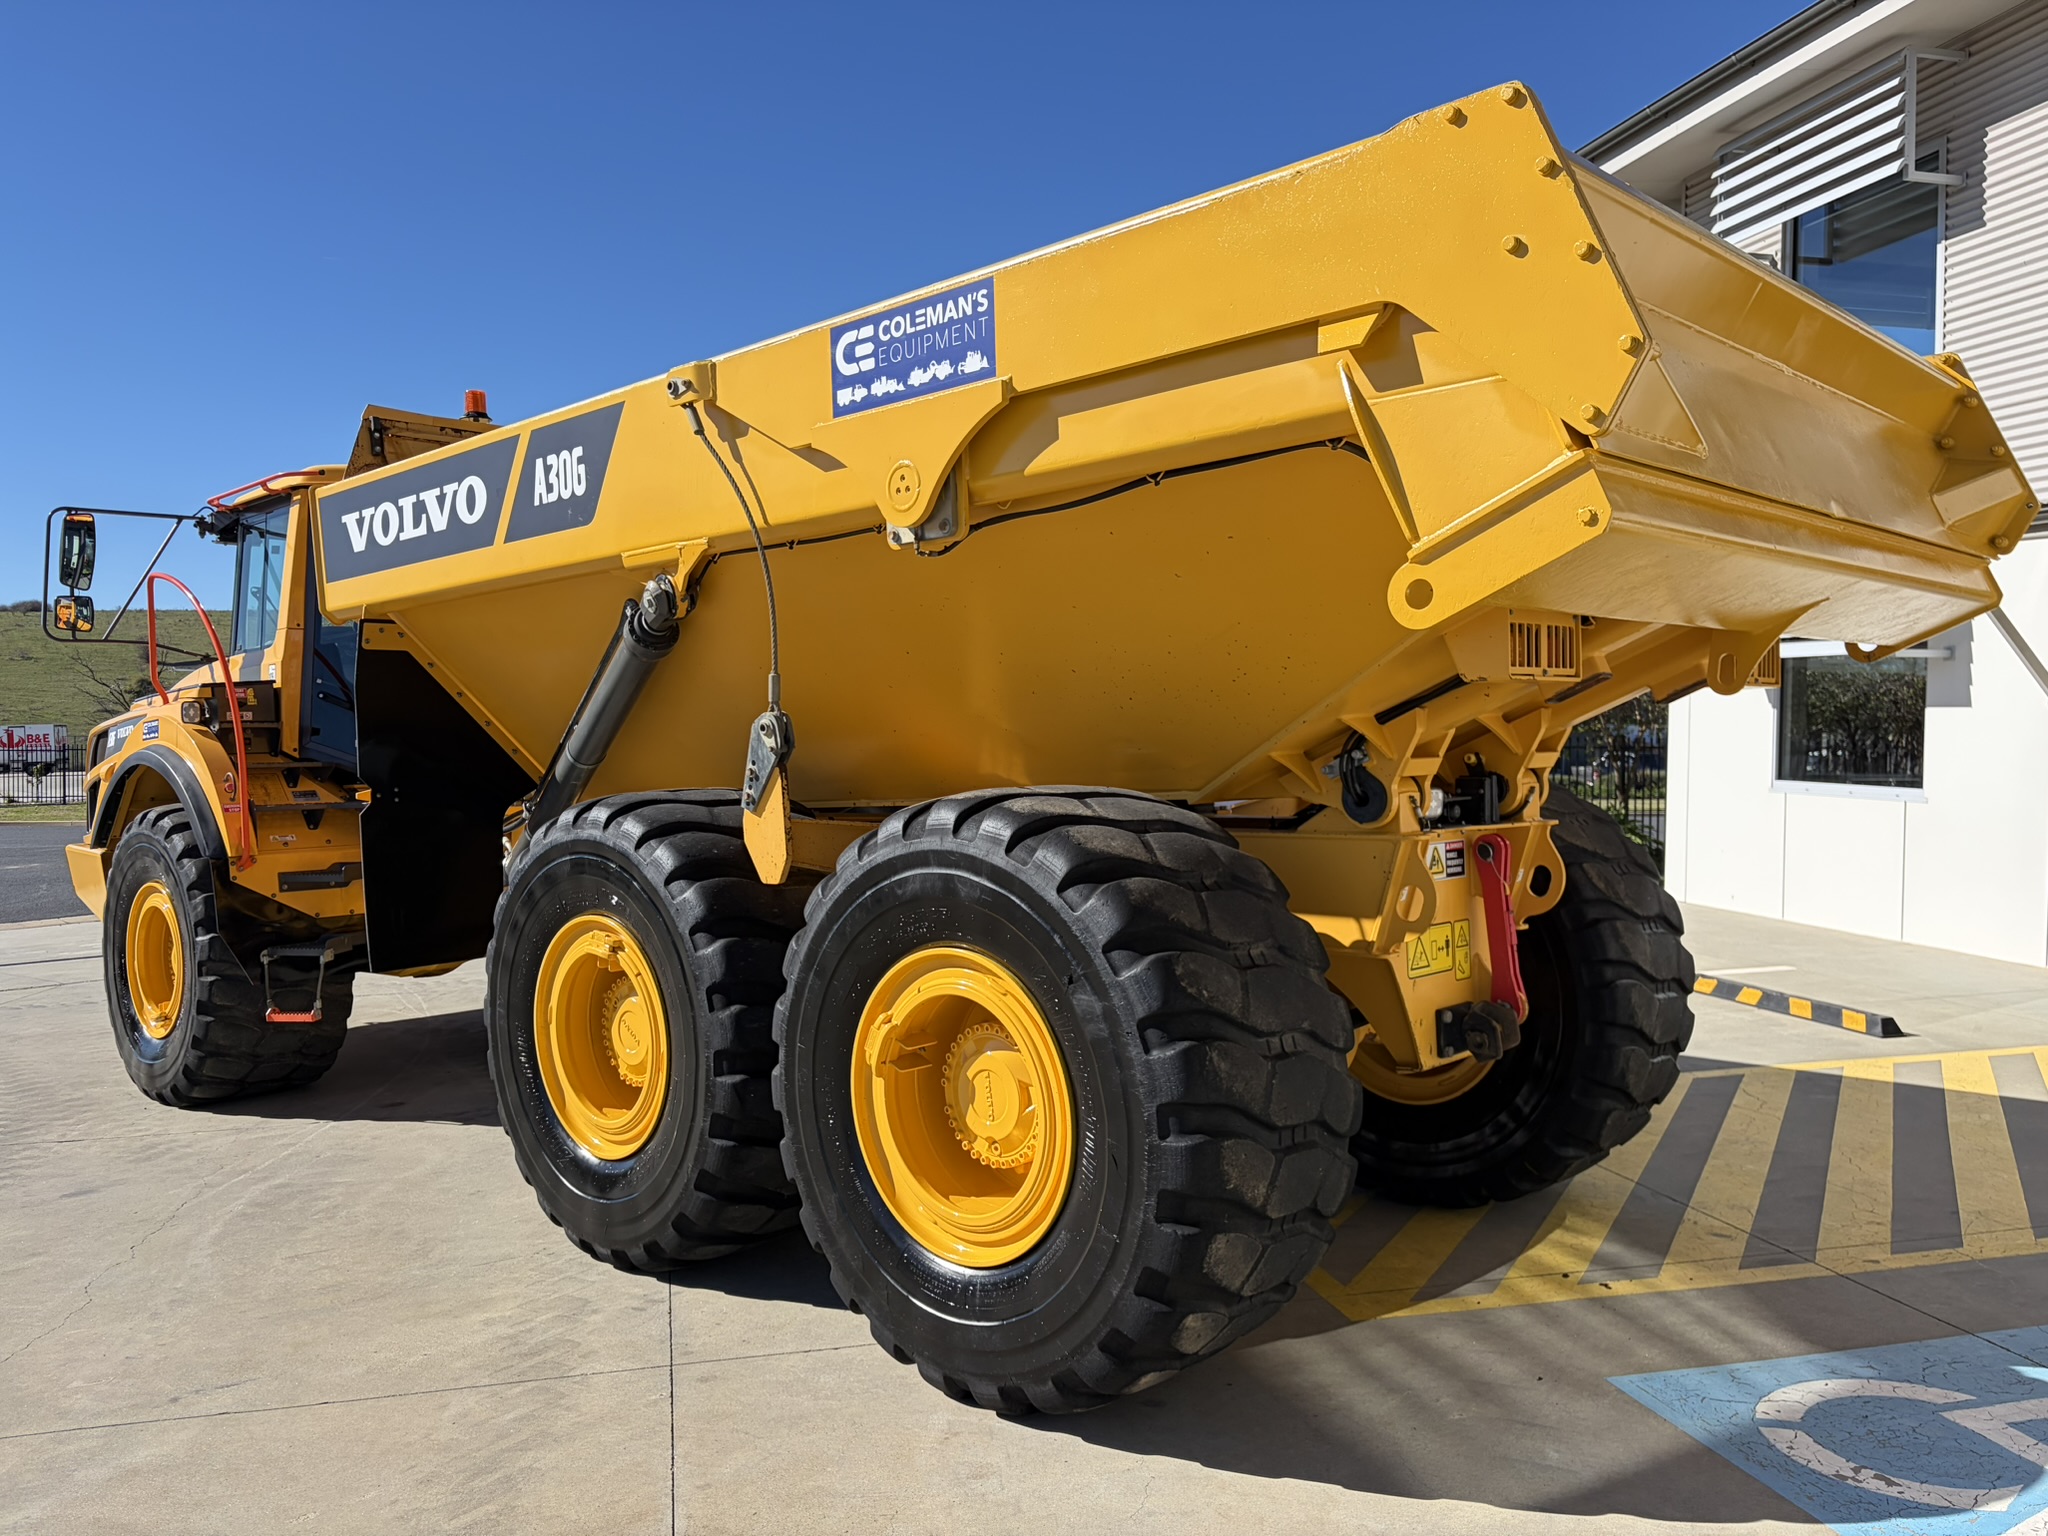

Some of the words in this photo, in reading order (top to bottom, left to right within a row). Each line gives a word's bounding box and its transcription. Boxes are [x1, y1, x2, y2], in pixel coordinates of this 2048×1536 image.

[878, 289, 989, 342] COLEMAN'S
[878, 316, 989, 367] EQUIPMENT
[534, 445, 587, 507] A30G
[341, 475, 488, 553] VOLVO
[26, 733, 50, 744] B&E
